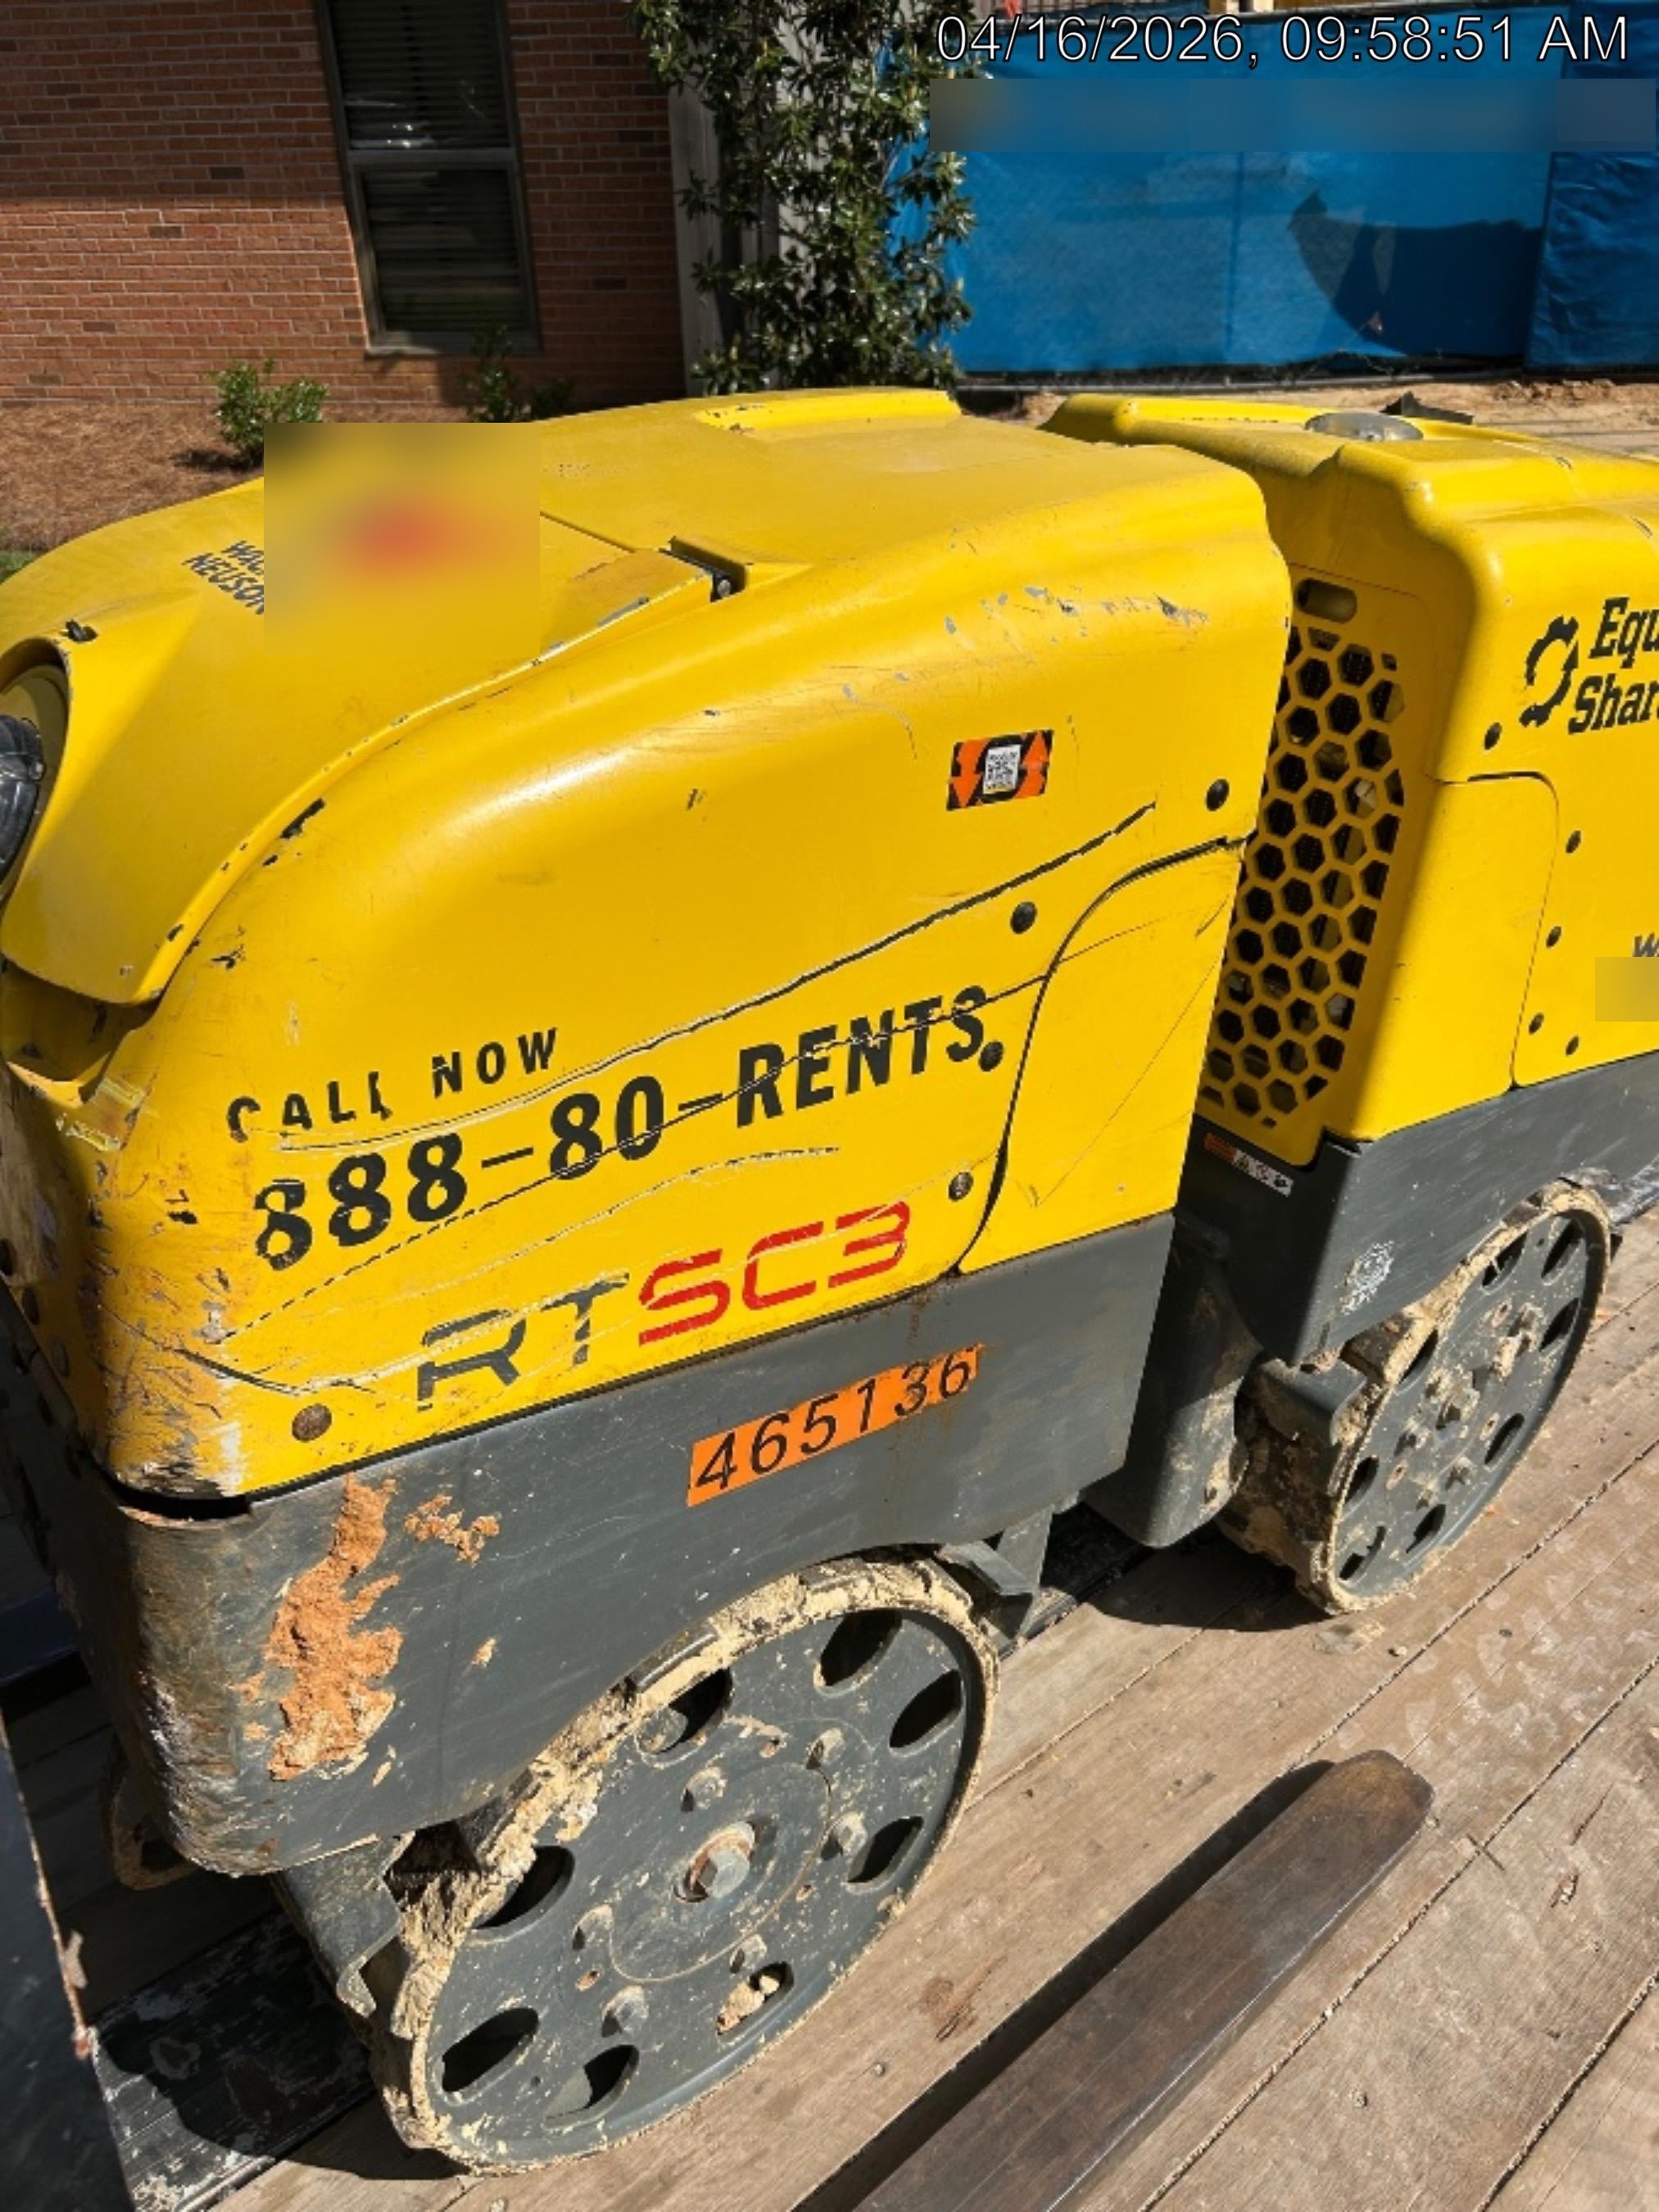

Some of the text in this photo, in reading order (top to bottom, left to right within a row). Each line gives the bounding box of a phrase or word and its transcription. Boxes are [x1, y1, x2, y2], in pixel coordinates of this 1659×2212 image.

[1567, 673, 1659, 735] Shar
[226, 1027, 557, 1143] CALL NOW
[695, 1349, 972, 1491] 465136
